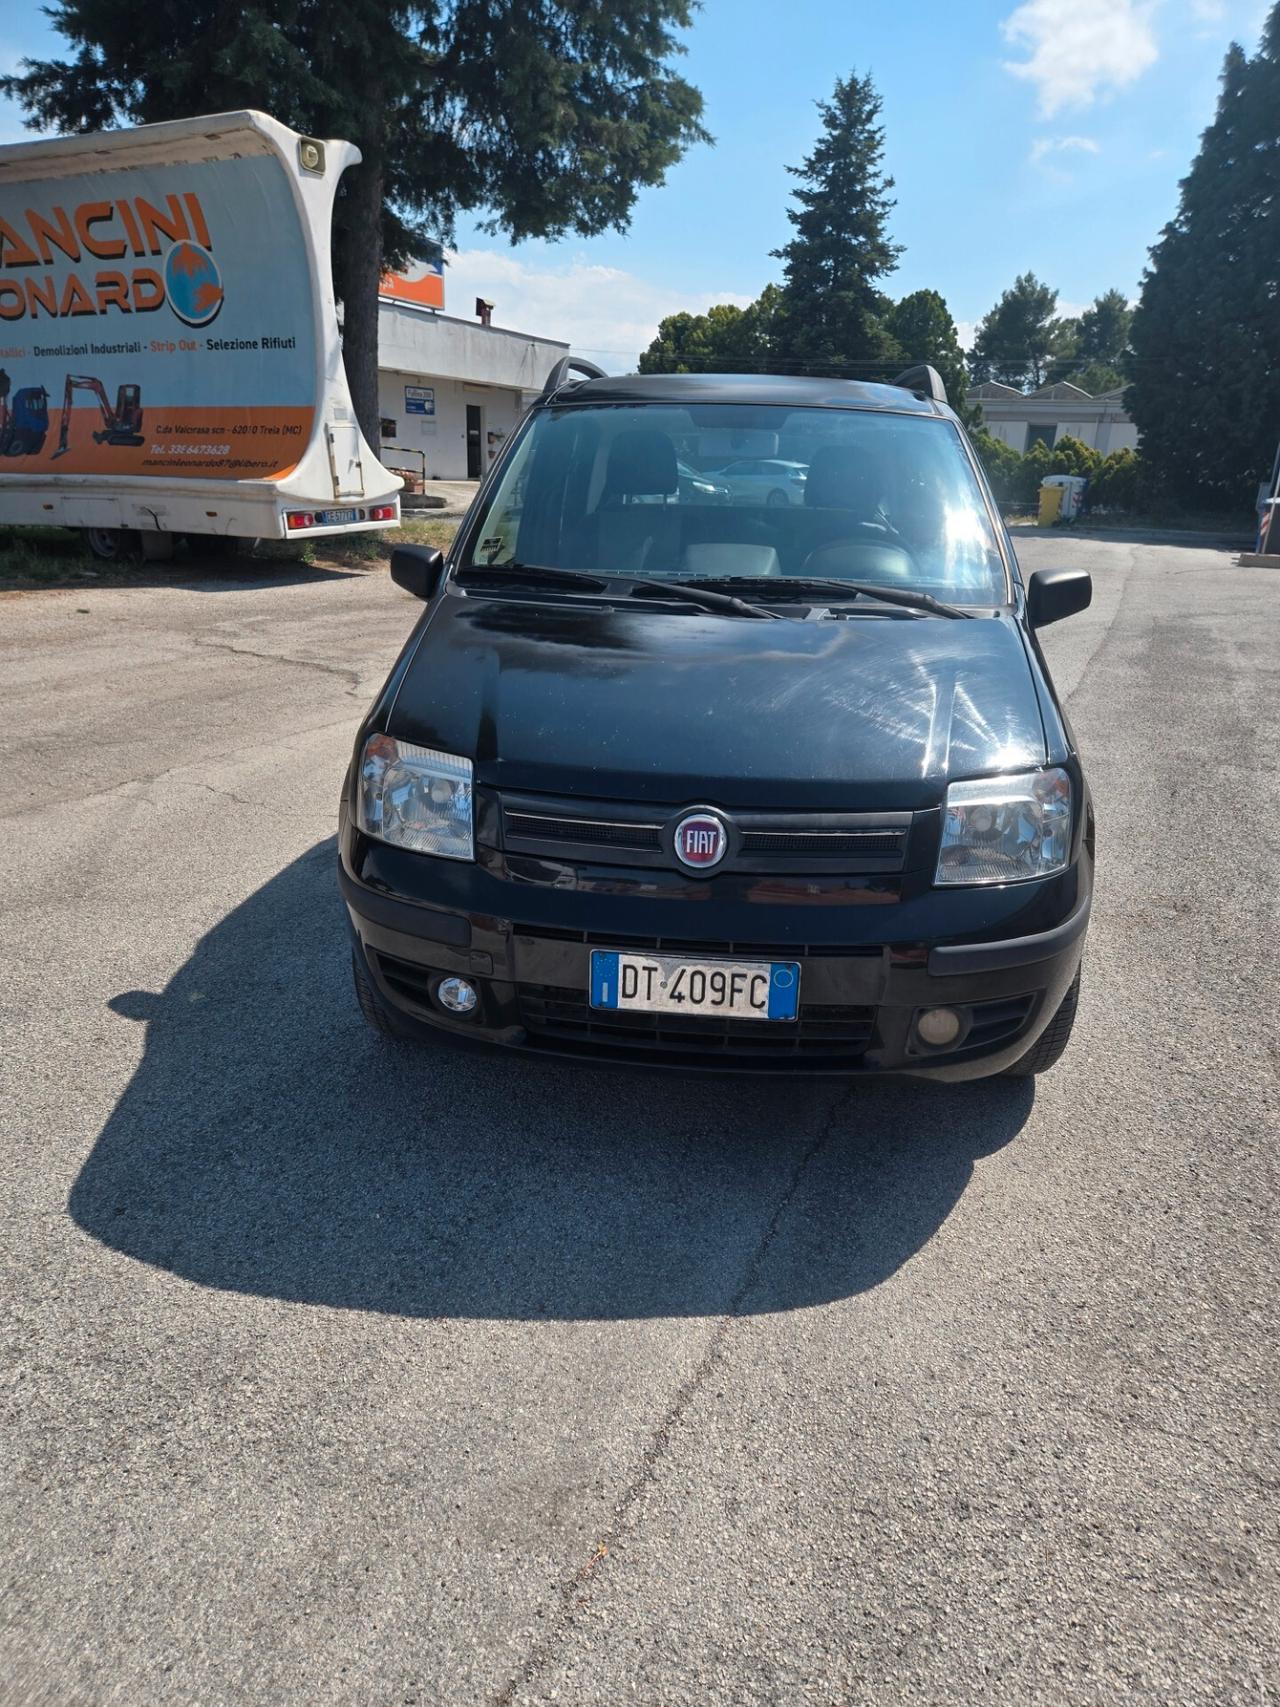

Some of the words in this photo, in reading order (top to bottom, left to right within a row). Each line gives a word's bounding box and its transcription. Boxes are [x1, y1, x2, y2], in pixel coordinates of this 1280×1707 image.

[33, 344, 88, 357] Demolizioni
[91, 341, 141, 355] Industriali
[150, 340, 176, 353] Strip
[179, 339, 197, 351] Out
[206, 338, 258, 350] Selezione
[261, 336, 296, 349] Rifiuti
[282, 424, 302, 435] (MC)
[686, 830, 717, 855] FIAT
[621, 964, 658, 1002] DT
[669, 968, 768, 1010] 409FC
